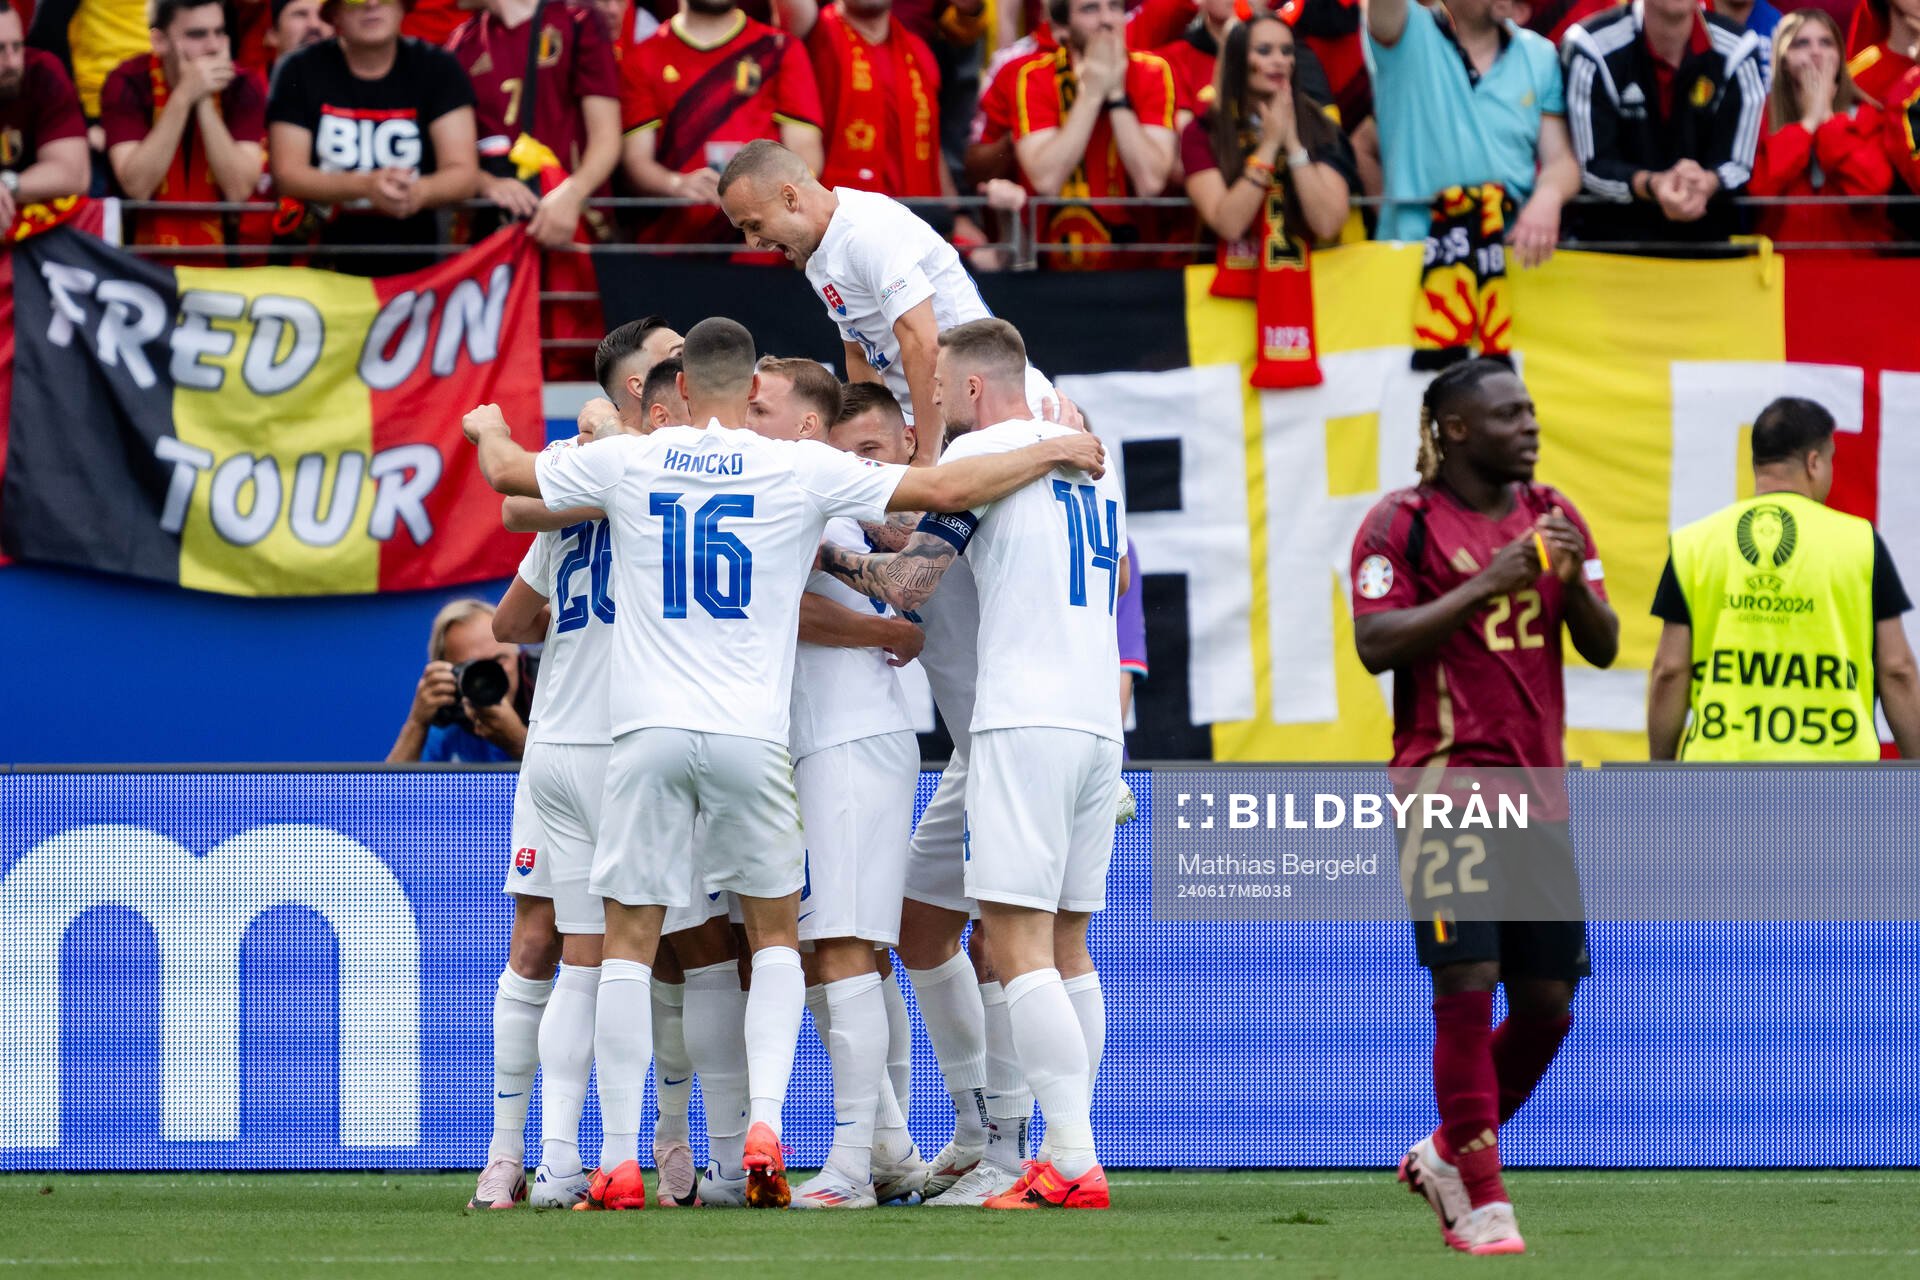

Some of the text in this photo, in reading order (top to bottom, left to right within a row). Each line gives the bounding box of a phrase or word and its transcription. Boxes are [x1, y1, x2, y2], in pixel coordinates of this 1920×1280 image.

[500, 78, 523, 125] 7
[316, 114, 421, 170] BIG
[41, 260, 512, 396] FRED ON
[154, 434, 443, 546] TOUR
[663, 448, 743, 476] HANCKO
[649, 492, 755, 619] 16
[1052, 479, 1120, 617] 14
[1484, 589, 1545, 651] 22
[1738, 612, 1791, 625] GERMANY
[1421, 833, 1490, 899] 22
